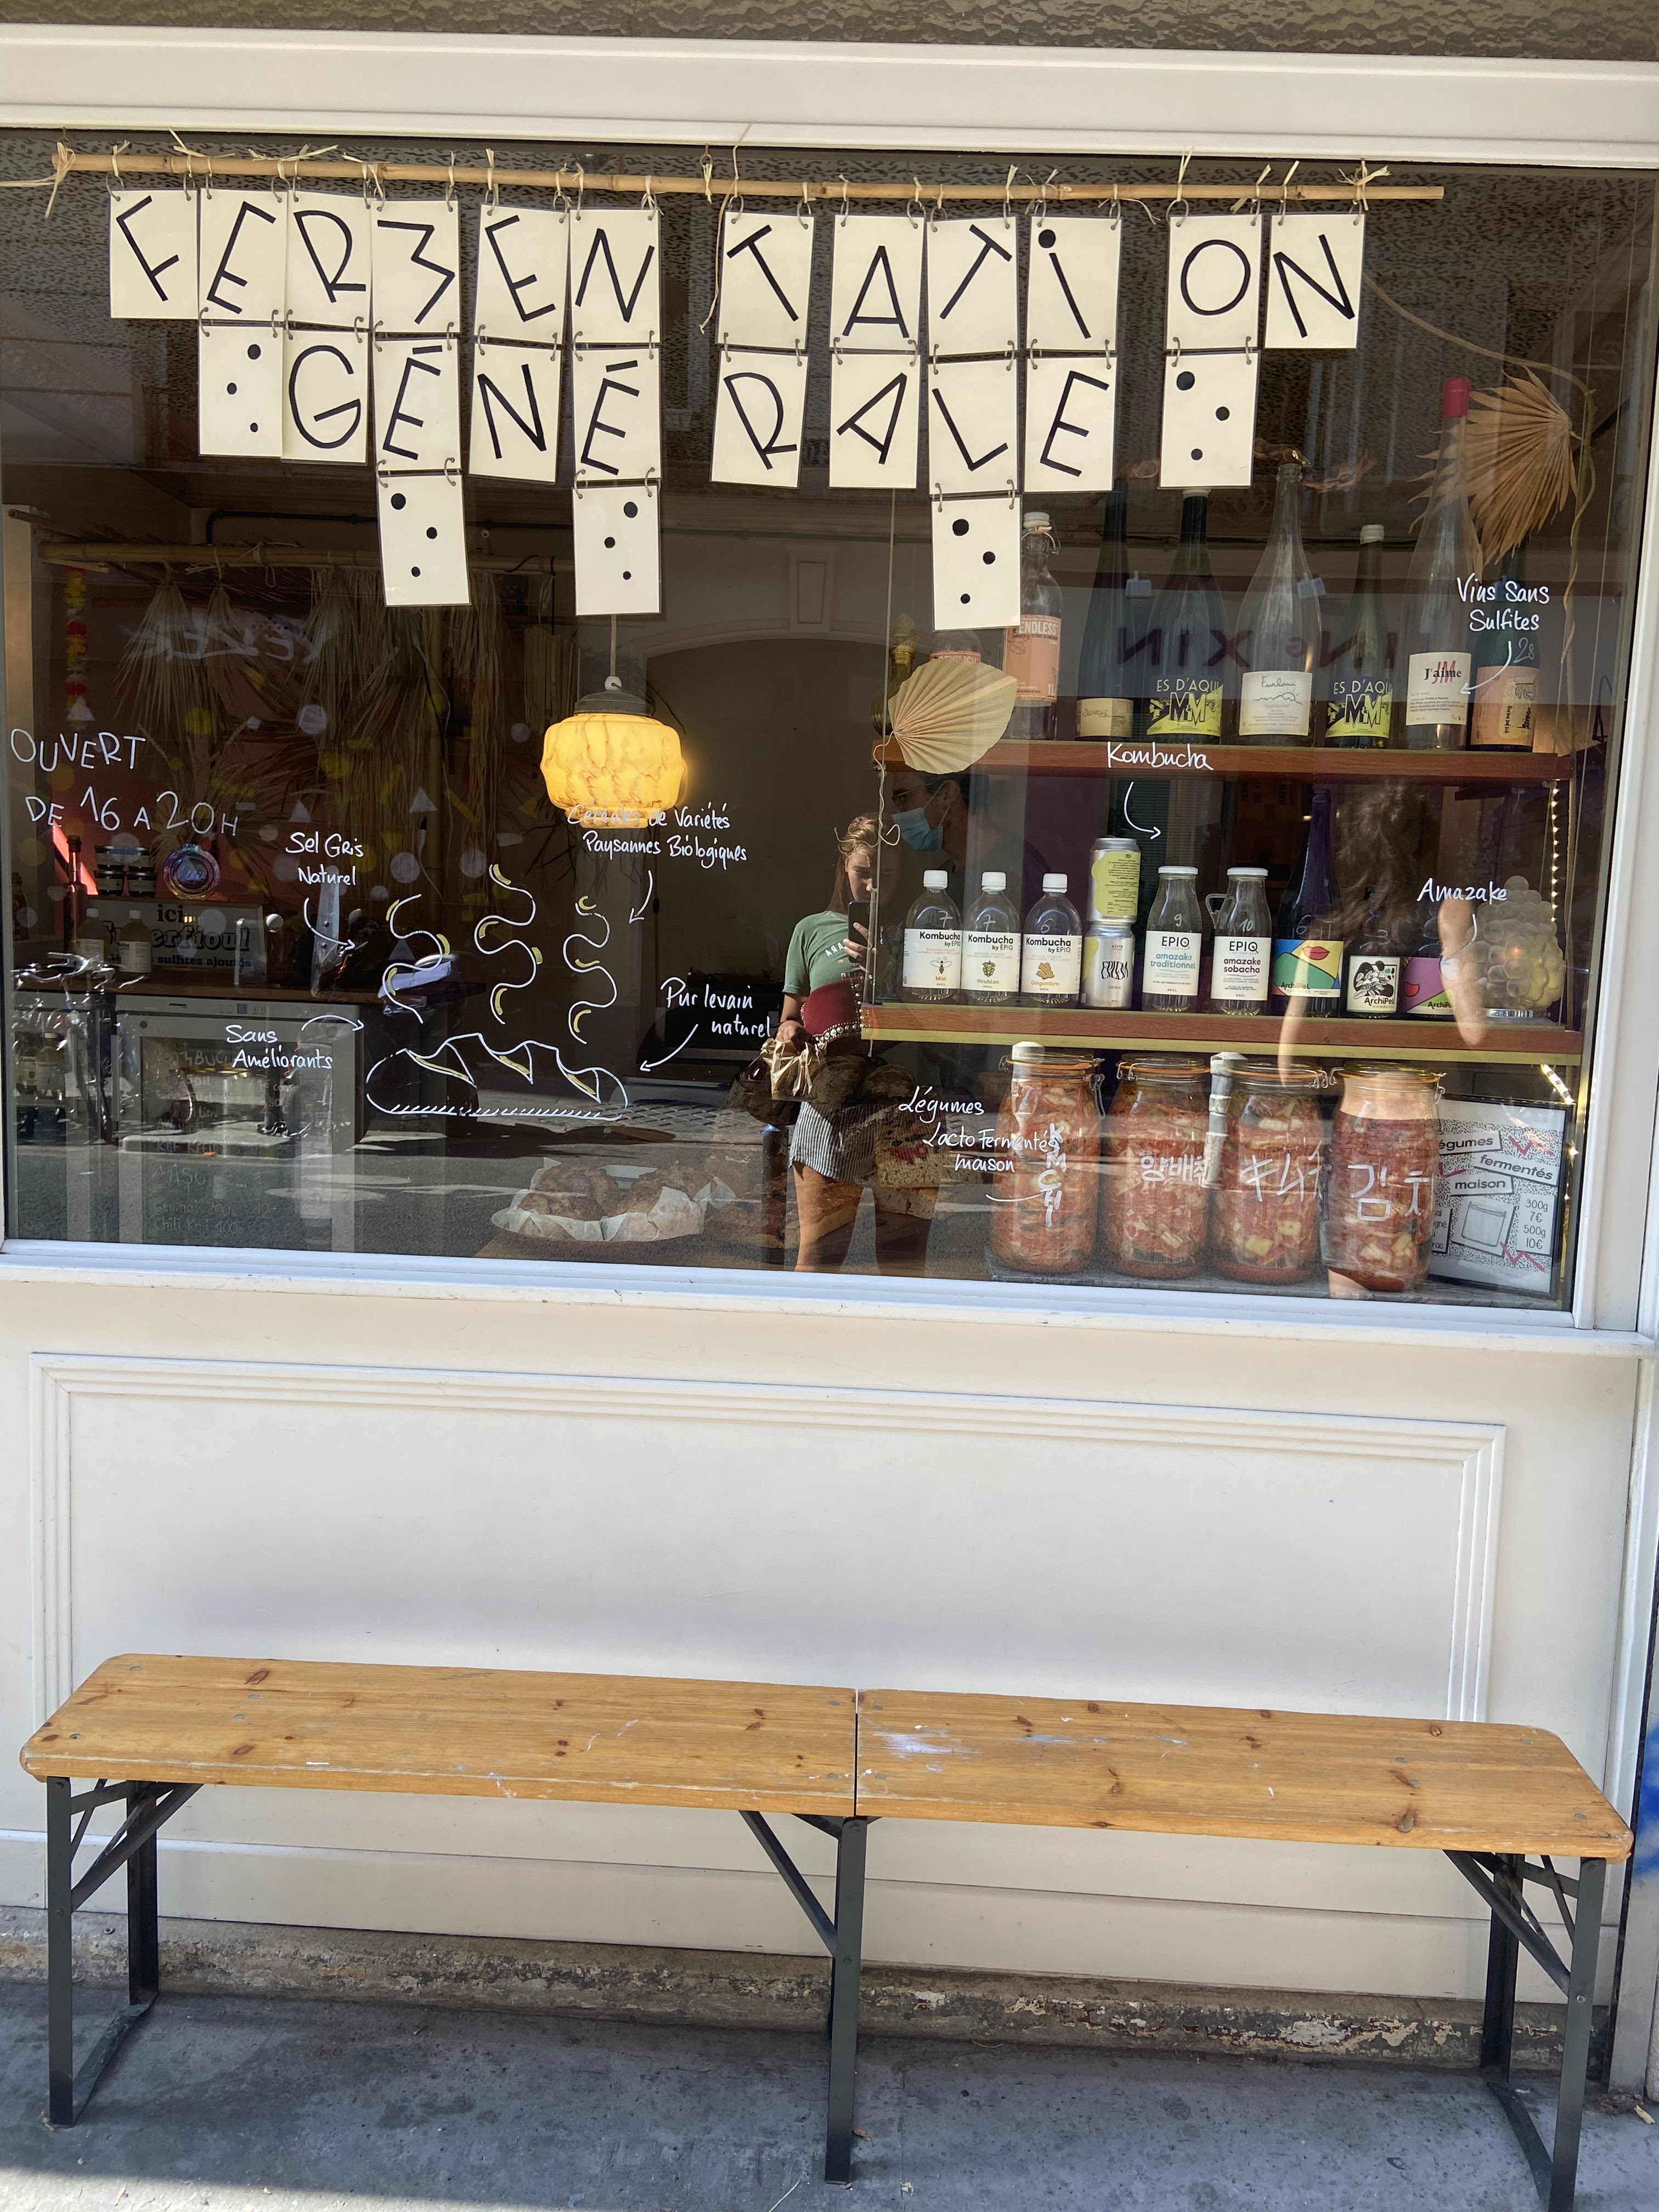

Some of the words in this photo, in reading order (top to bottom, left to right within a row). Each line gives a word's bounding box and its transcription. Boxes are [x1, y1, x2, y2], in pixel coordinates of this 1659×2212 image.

[1505, 580, 1550, 605] Sans
[1469, 609, 1540, 632] Sulfites
[1019, 622, 1058, 636] ENDLESS
[1424, 667, 1462, 680] J'aime
[1156, 679, 1170, 692] ES
[1333, 681, 1345, 695] ES
[10, 728, 146, 772] OUVERT
[1107, 741, 1214, 771] Kombucha
[25, 796, 64, 827] DE
[80, 786, 121, 831] 16
[133, 806, 151, 831] A
[648, 807, 668, 827] de
[674, 801, 731, 830] Variétés
[285, 831, 319, 854] Sel
[582, 830, 662, 861] Paysannes
[667, 834, 748, 871] Biologiques
[298, 863, 357, 886] Naturel
[1417, 877, 1507, 905] Amazake
[938, 910, 953, 928] 7
[1041, 918, 1054, 933] 6
[1173, 913, 1182, 927] 9
[1239, 918, 1254, 932] 10
[919, 931, 961, 940] Kombucha
[968, 934, 1014, 944] Kombucha
[1026, 937, 1071, 946] Kombucha
[1229, 941, 1259, 953] EPIQ
[1150, 961, 1195, 969] traditionnel
[1223, 957, 1261, 966] amazake
[660, 976, 698, 1008] Pur
[704, 984, 753, 1009] levain
[711, 1013, 771, 1038] naturel
[225, 1024, 278, 1044] Sans
[232, 1046, 334, 1070] Améliorants
[898, 1086, 985, 1124] Légumes
[922, 1122, 975, 1148] Lacto
[978, 1128, 1060, 1155] Fermentés
[1438, 1137, 1493, 1150] égumes
[955, 1153, 1015, 1173] maison
[1480, 1154, 1553, 1180] fermentés
[1454, 1180, 1506, 1189] maison
[1525, 1199, 1548, 1212] 300g
[1530, 1211, 1543, 1223] 7€
[1523, 1224, 1547, 1238] 500g
[1526, 1237, 1543, 1250] 10€
